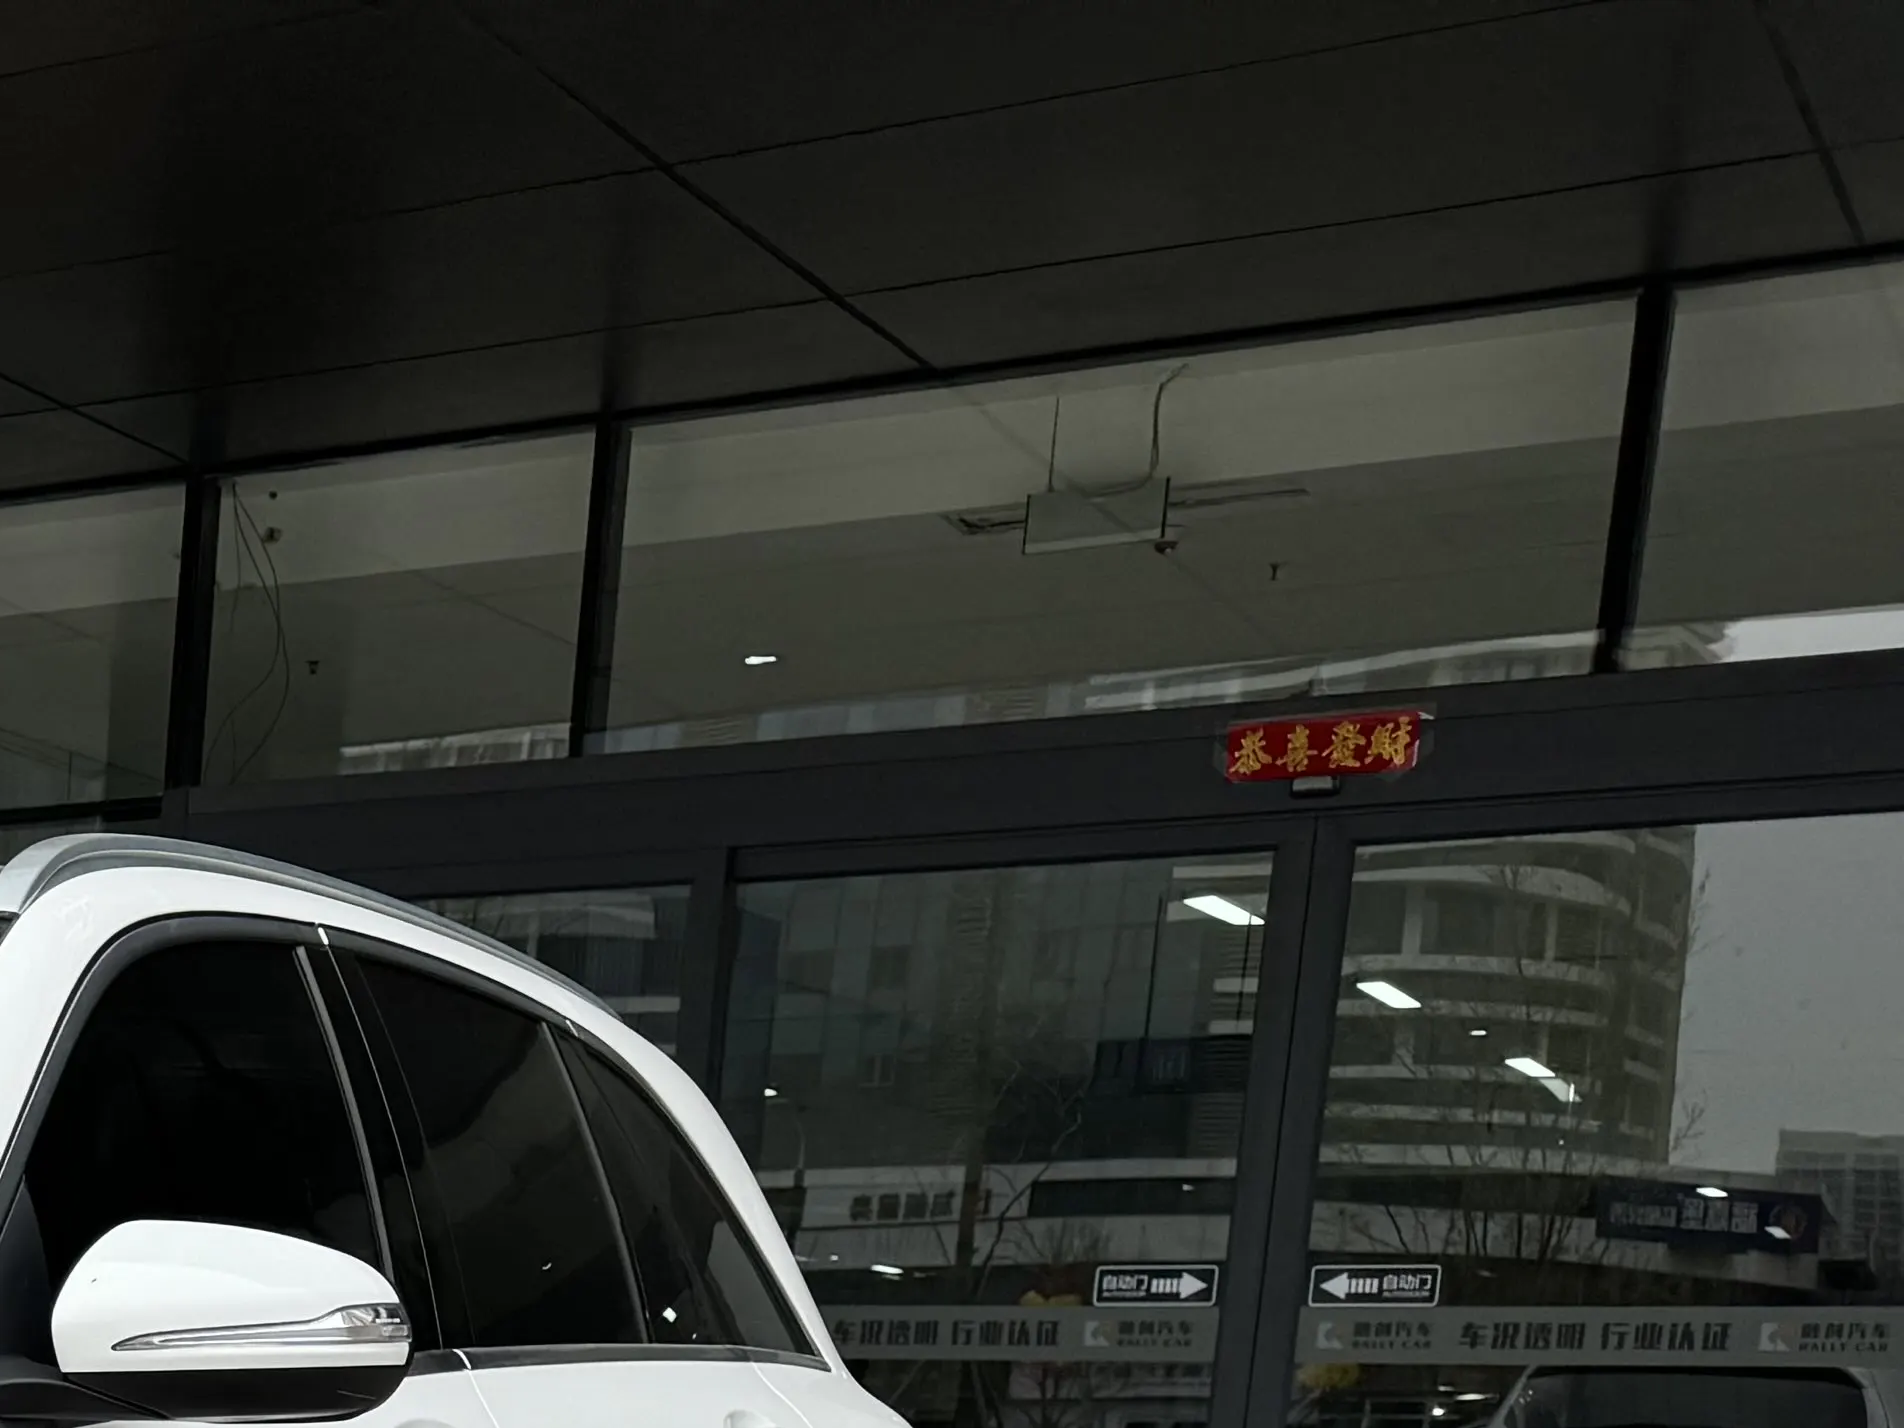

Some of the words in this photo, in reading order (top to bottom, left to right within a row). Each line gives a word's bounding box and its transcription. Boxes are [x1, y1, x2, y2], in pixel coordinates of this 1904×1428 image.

[1383, 1273, 1432, 1290] 自动门
[950, 1319, 1060, 1347] 行业认证
[1458, 1321, 1587, 1351] 车况透明
[1599, 1321, 1733, 1351] 行业认证
